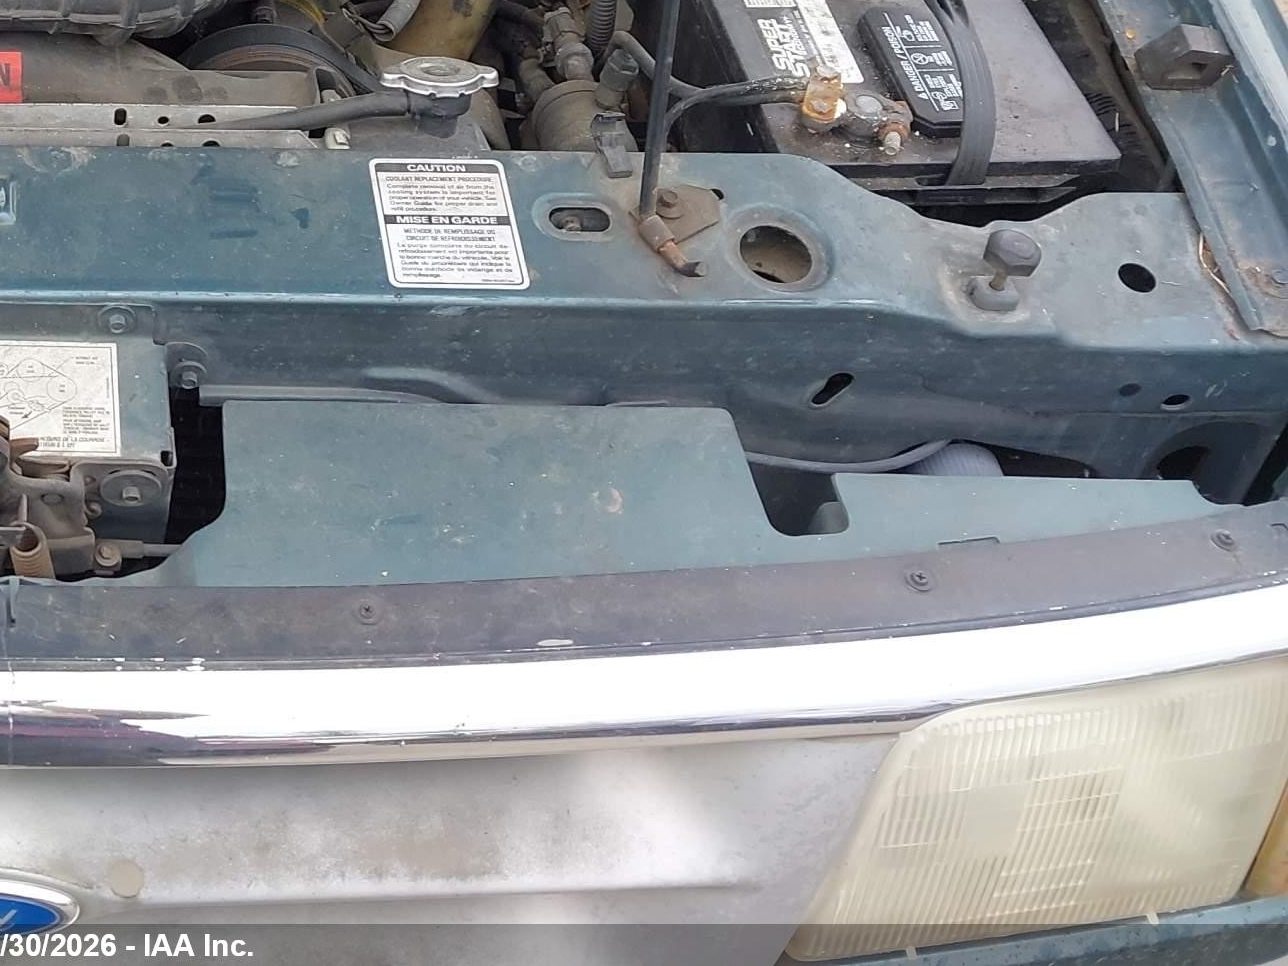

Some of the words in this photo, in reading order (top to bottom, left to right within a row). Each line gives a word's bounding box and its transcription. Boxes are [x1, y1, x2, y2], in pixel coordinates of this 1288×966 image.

[757, 18, 792, 71] SUPER
[772, 18, 811, 78] START
[881, 26, 905, 54] POISON
[900, 60, 925, 92] DANGER
[406, 164, 466, 172] CAUTION
[396, 216, 430, 224] MISE
[430, 216, 450, 224] EN
[451, 216, 498, 224] GARDE
